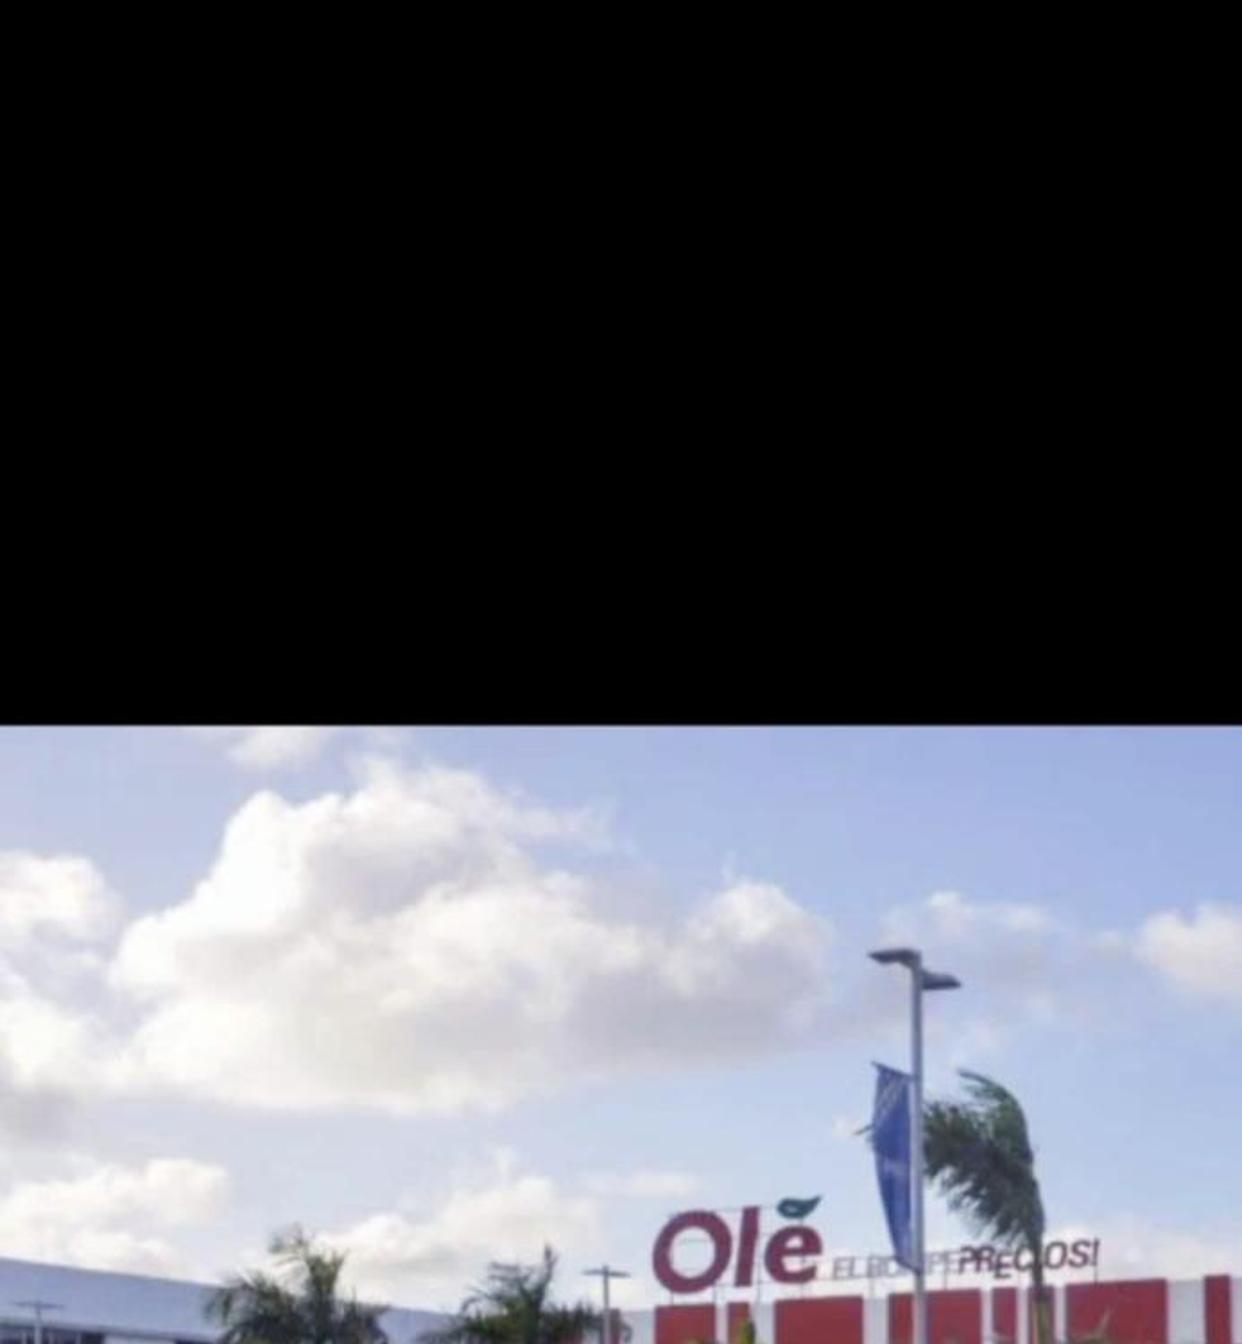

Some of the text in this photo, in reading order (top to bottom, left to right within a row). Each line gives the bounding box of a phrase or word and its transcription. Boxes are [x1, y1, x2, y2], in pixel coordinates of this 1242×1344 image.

[653, 1195, 823, 1294] Olé
[832, 1256, 866, 1279] EL
[957, 1238, 1100, 1279] PRECOS!
